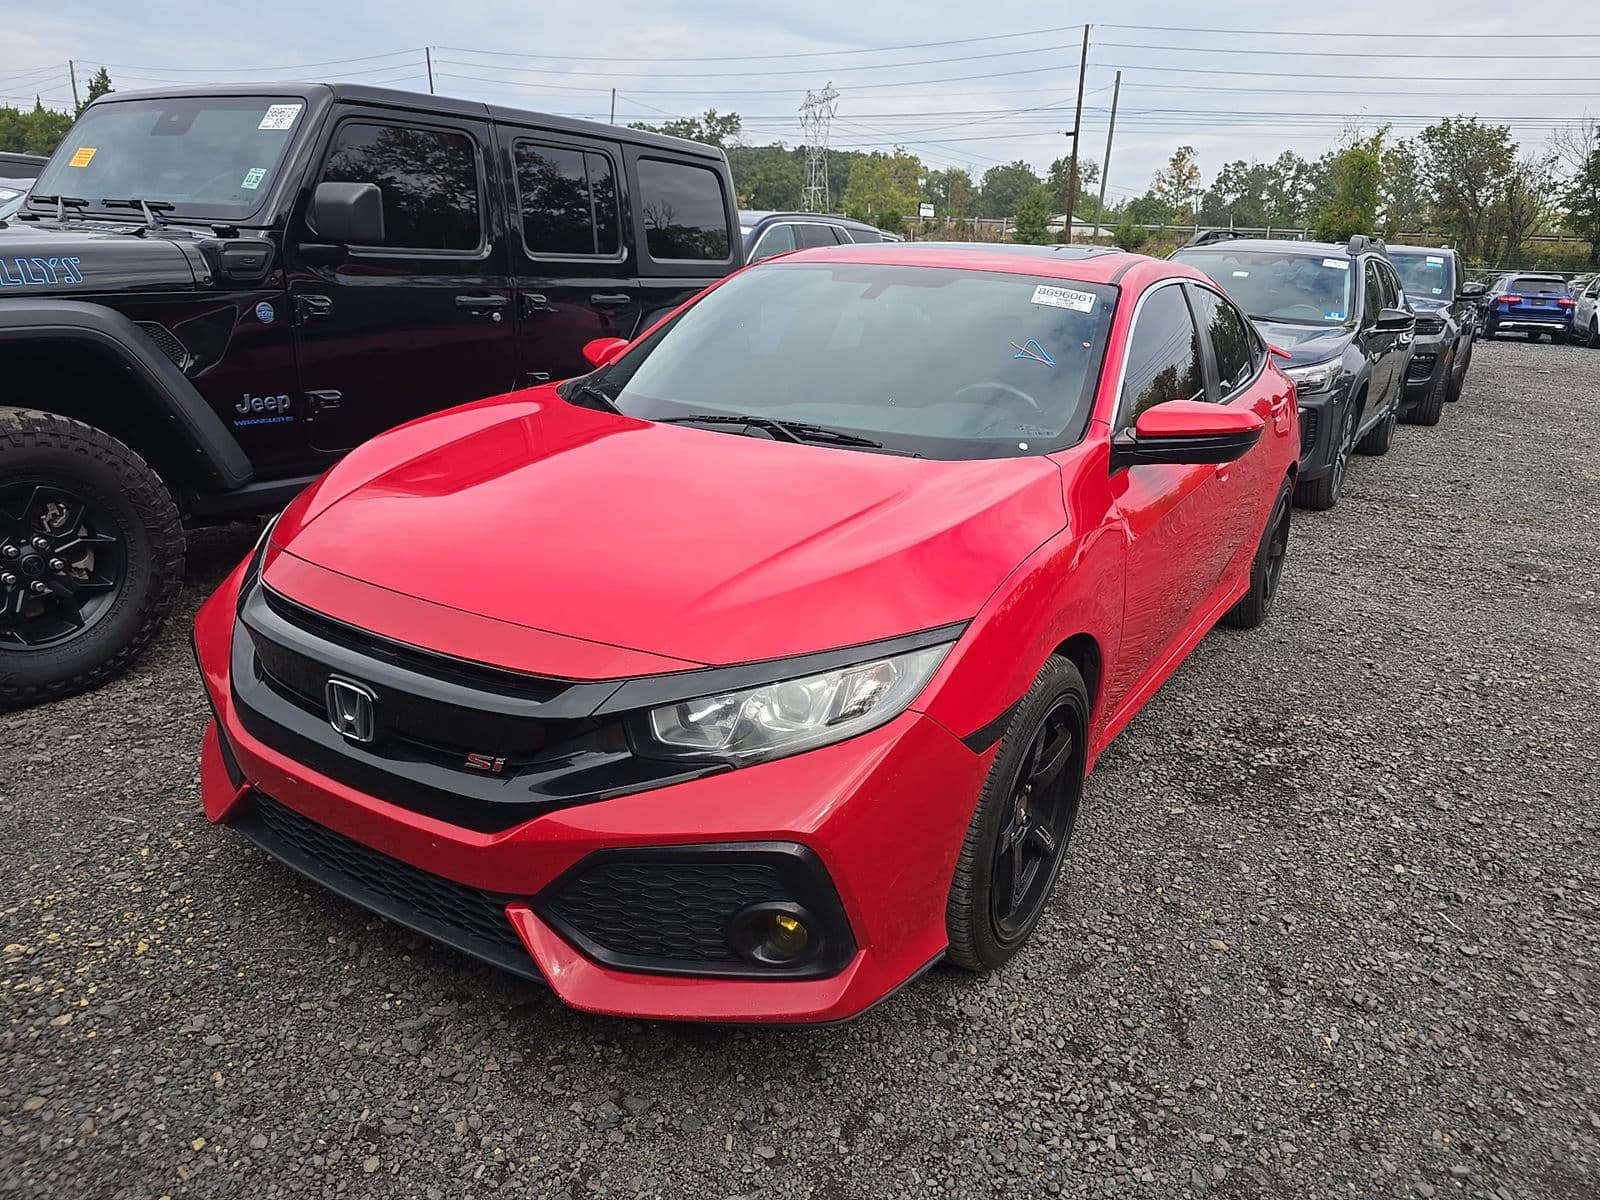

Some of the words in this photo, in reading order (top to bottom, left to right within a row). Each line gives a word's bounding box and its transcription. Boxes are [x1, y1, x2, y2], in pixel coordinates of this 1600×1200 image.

[1038, 287, 1093, 303] 8696061
[235, 393, 291, 414] Jeep
[464, 753, 506, 772] Si
